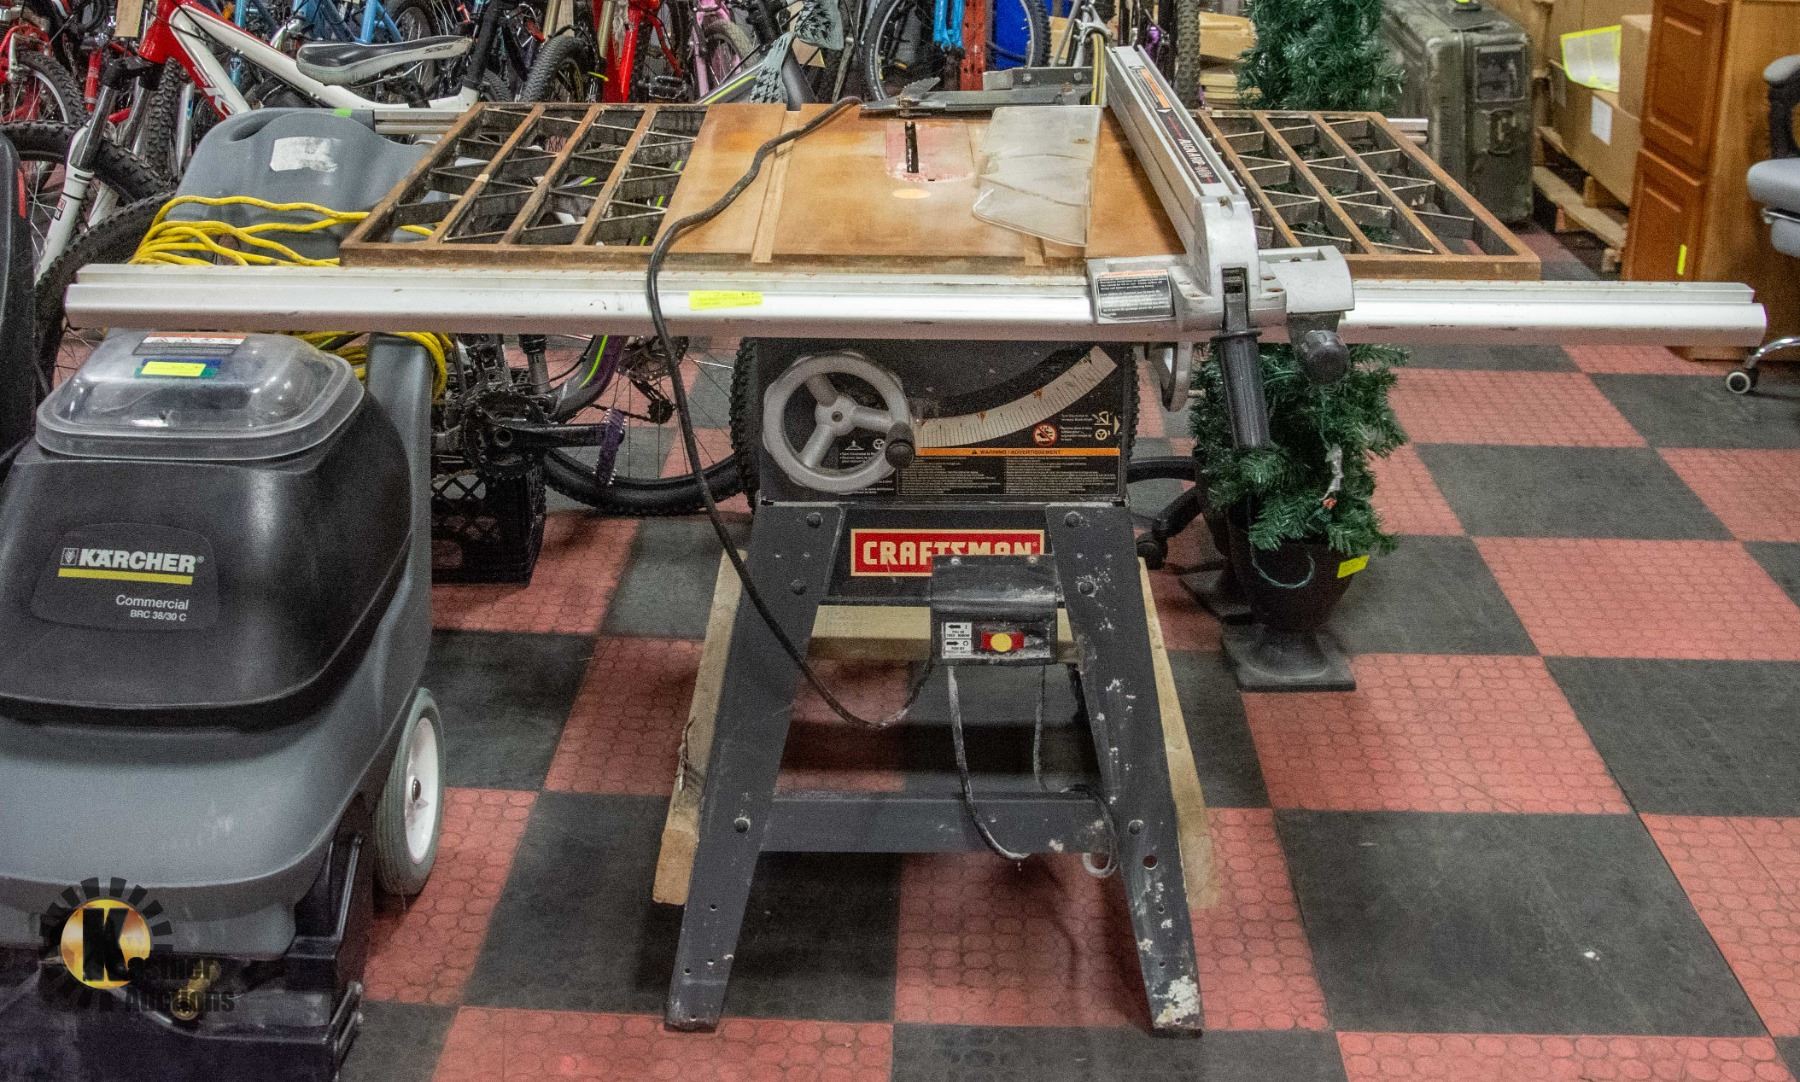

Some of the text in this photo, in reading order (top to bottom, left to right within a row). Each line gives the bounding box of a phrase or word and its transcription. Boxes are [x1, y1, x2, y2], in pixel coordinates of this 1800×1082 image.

[78, 548, 196, 573] KÄRCHER
[863, 542, 1033, 565] CRAFTSMAN
[115, 594, 189, 611] Commercial
[130, 609, 151, 619] BRC
[178, 613, 187, 622] C
